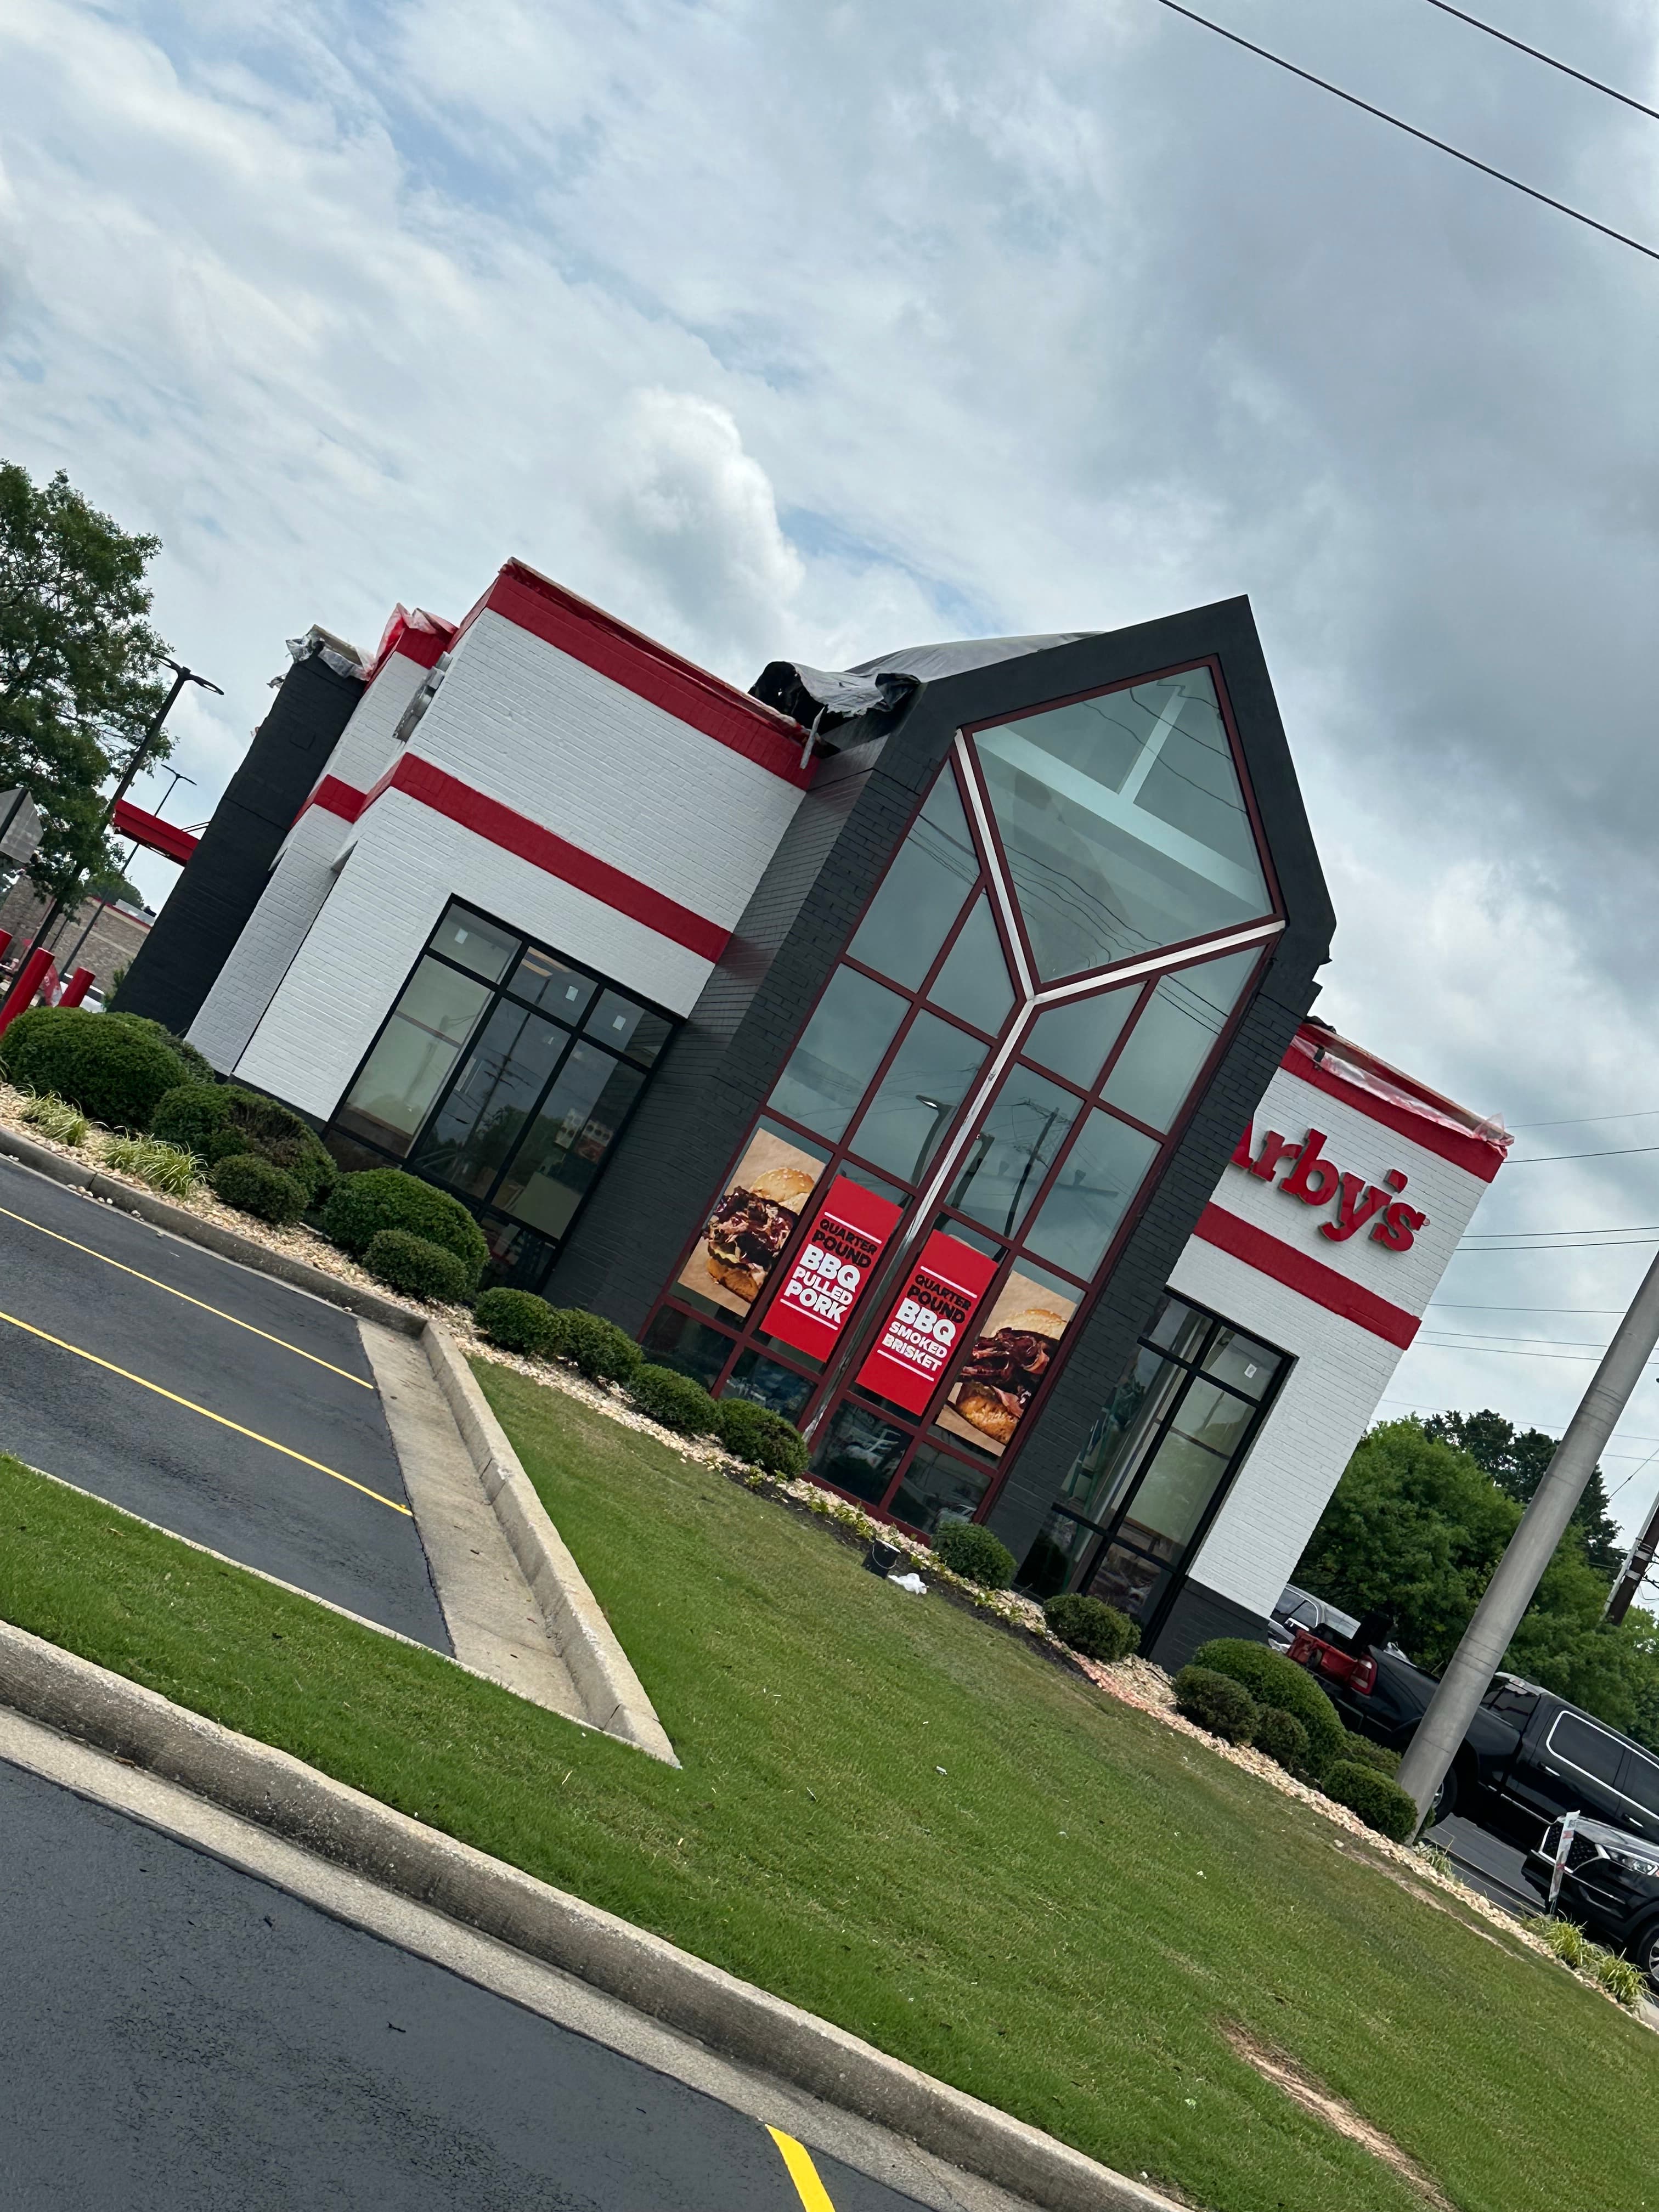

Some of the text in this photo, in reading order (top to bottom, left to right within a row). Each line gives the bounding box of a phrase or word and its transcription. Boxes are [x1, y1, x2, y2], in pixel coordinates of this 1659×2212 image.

[812, 1229, 872, 1268] POUND
[820, 1218, 878, 1255] QUARTER
[792, 1266, 853, 1306] PULLED
[799, 1243, 860, 1293] BBQ
[783, 1279, 848, 1324] PORK
[907, 1284, 966, 1324] POUND
[915, 1274, 972, 1311] QUARTER
[888, 1321, 948, 1358] SMOKED
[895, 1297, 957, 1347] BBQ
[881, 1333, 943, 1372] BRISKET
